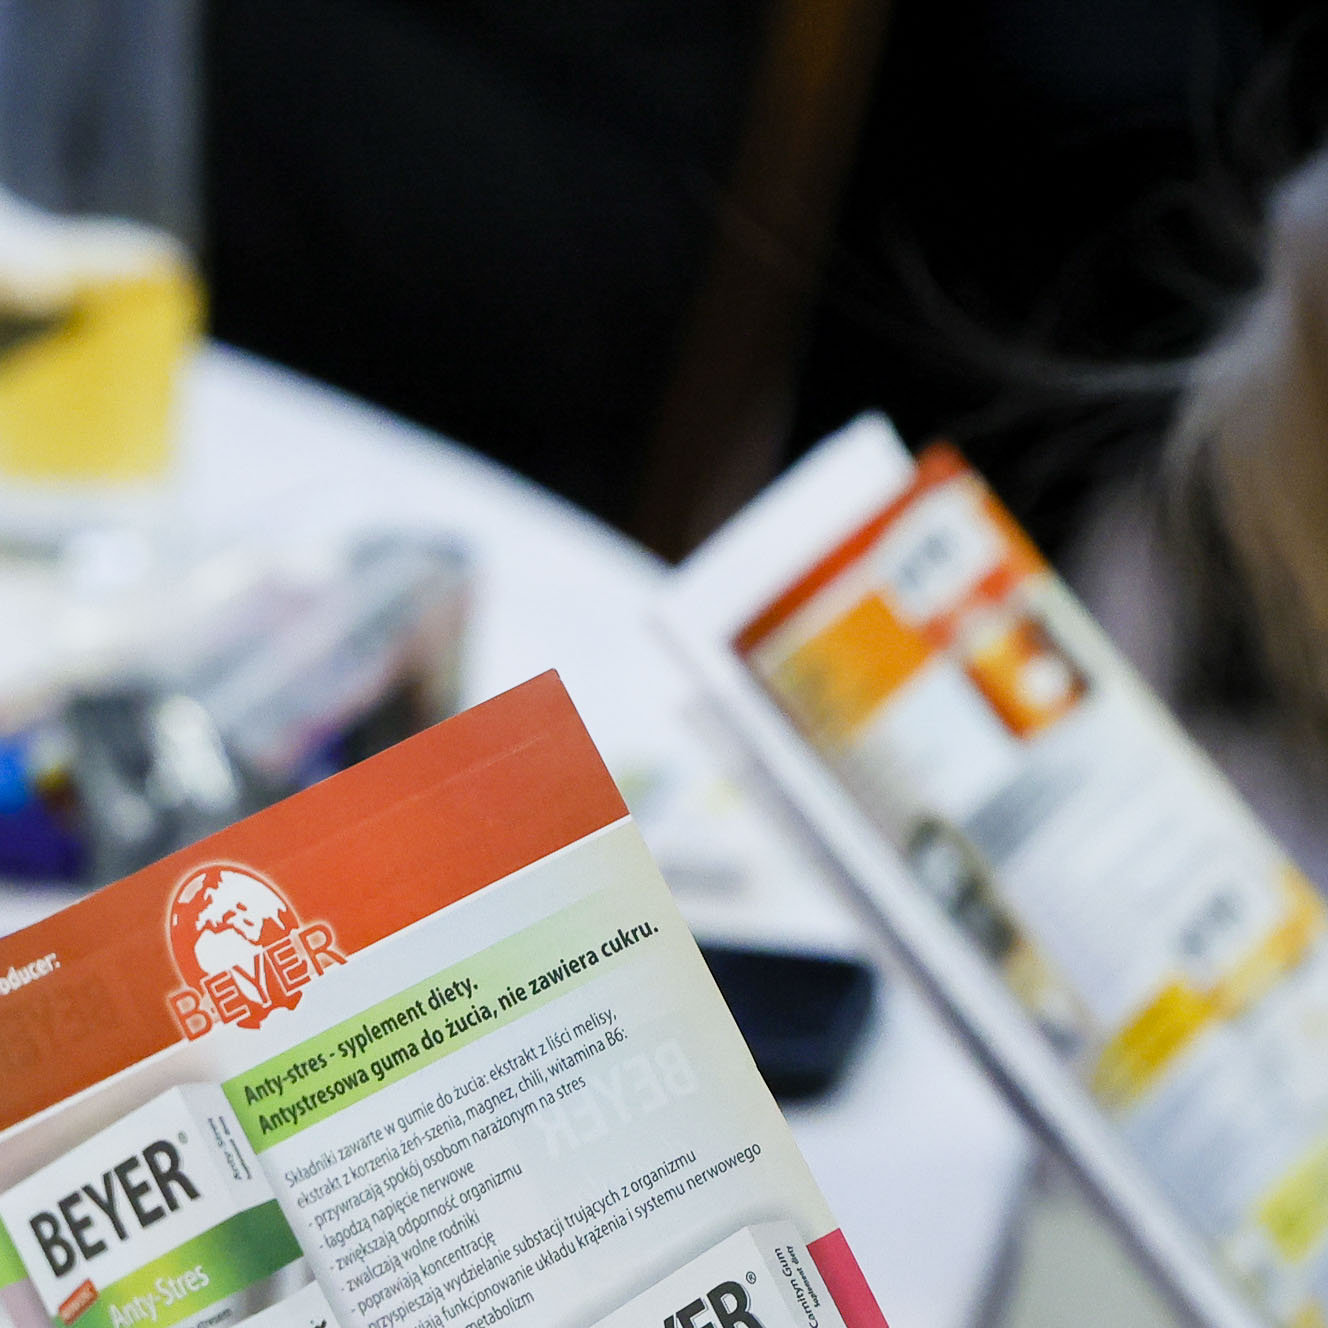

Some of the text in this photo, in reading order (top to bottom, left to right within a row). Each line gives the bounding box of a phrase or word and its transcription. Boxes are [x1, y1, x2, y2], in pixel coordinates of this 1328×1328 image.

[167, 921, 349, 1042] BEYER
[243, 977, 478, 1106] Anty-stres syplement diety.
[258, 921, 659, 1135] Antystresowa guma do żucia, nie zawiera cukru.
[296, 1026, 628, 1208] ekstrakt z korzenia żeń-szenia, magnez, chili, witamina B6:
[313, 1075, 586, 1230] przywracają spokój osobom narażonym na stres
[336, 1128, 384, 1161] zawarte
[383, 1121, 396, 1135] w
[396, 1101, 436, 1133] gumie
[435, 1092, 453, 1109] do
[452, 1073, 489, 1100] żucia:
[488, 1046, 538, 1081] ekstrakt
[537, 1043, 548, 1056] z
[544, 1026, 572, 1051] liści
[571, 1008, 617, 1038] melisy,
[322, 1161, 475, 1248] łagodzą napięcie nerwowe
[334, 1163, 523, 1271] zwiększają odporność organizmu
[345, 1208, 480, 1292] zwalczają wolne rodniki
[440, 1263, 535, 1321] funkcjonowanie
[534, 1241, 577, 1271] układu
[573, 1214, 628, 1249] krążenia
[625, 1207, 634, 1221] i
[633, 1182, 686, 1219] systemu
[685, 1143, 761, 1190] nerwowego
[442, 1248, 512, 1293] wydzielanie
[511, 1217, 565, 1256] substacji
[563, 1188, 621, 1228] trujących
[620, 1185, 630, 1198] z
[629, 1149, 696, 1193] organizmu
[356, 1231, 497, 1316] poprawiają koncentrację
